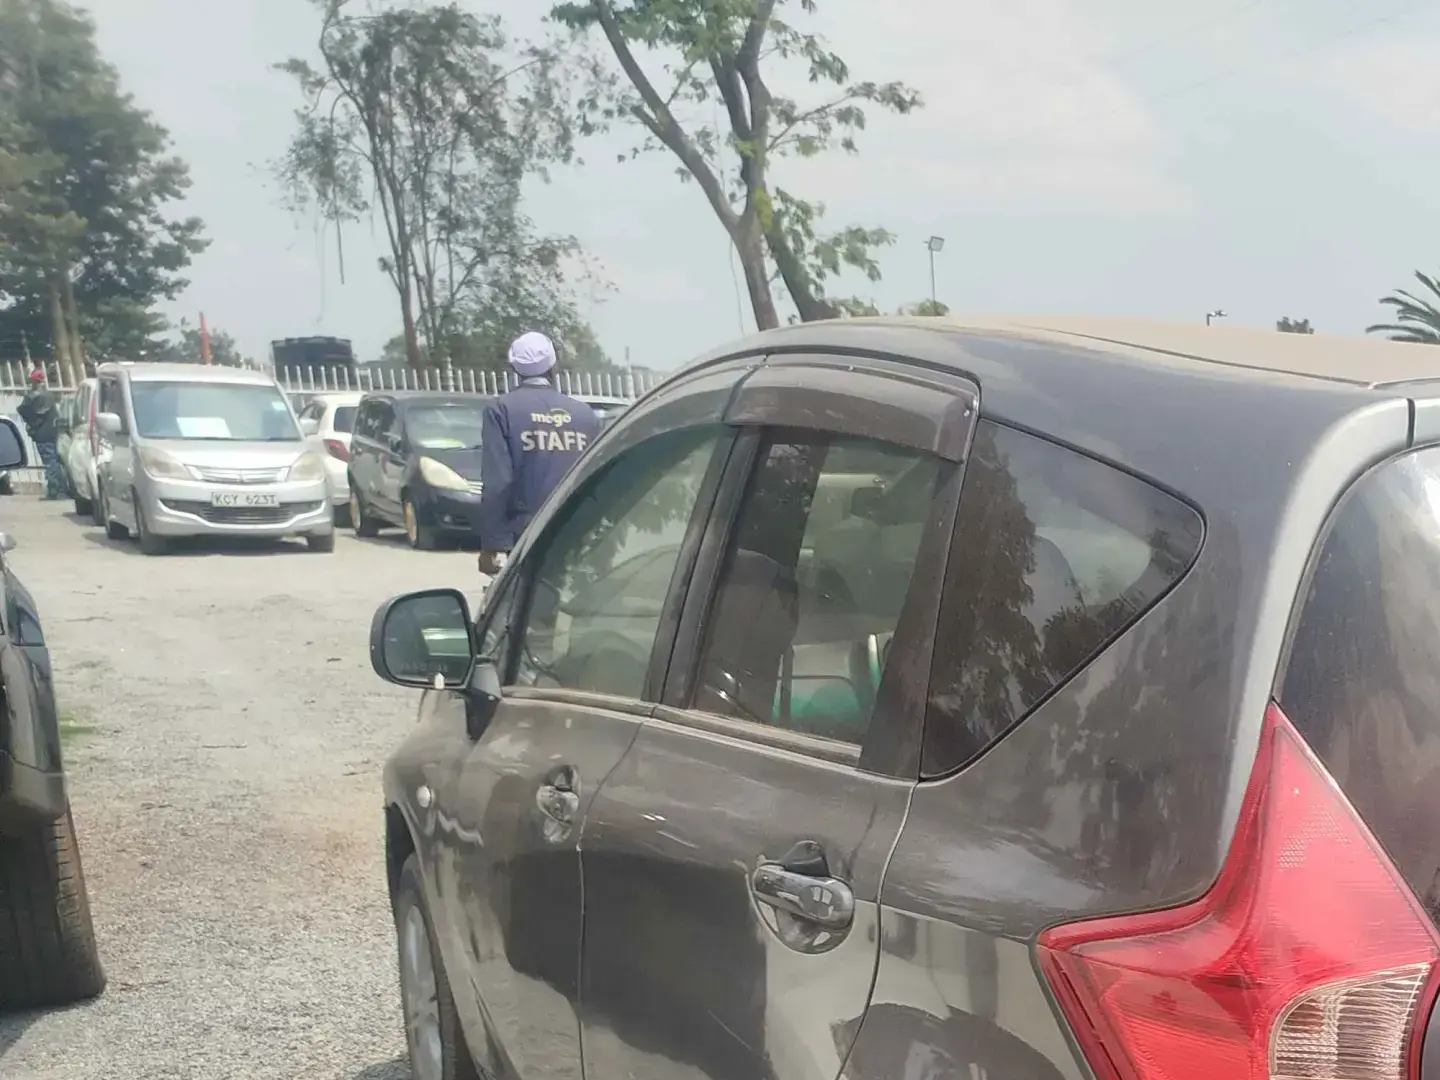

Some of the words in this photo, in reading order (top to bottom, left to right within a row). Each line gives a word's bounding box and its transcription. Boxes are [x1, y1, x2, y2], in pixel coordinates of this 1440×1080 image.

[530, 411, 572, 428] mogo
[520, 430, 588, 451] STAFF
[214, 494, 238, 505] KCY
